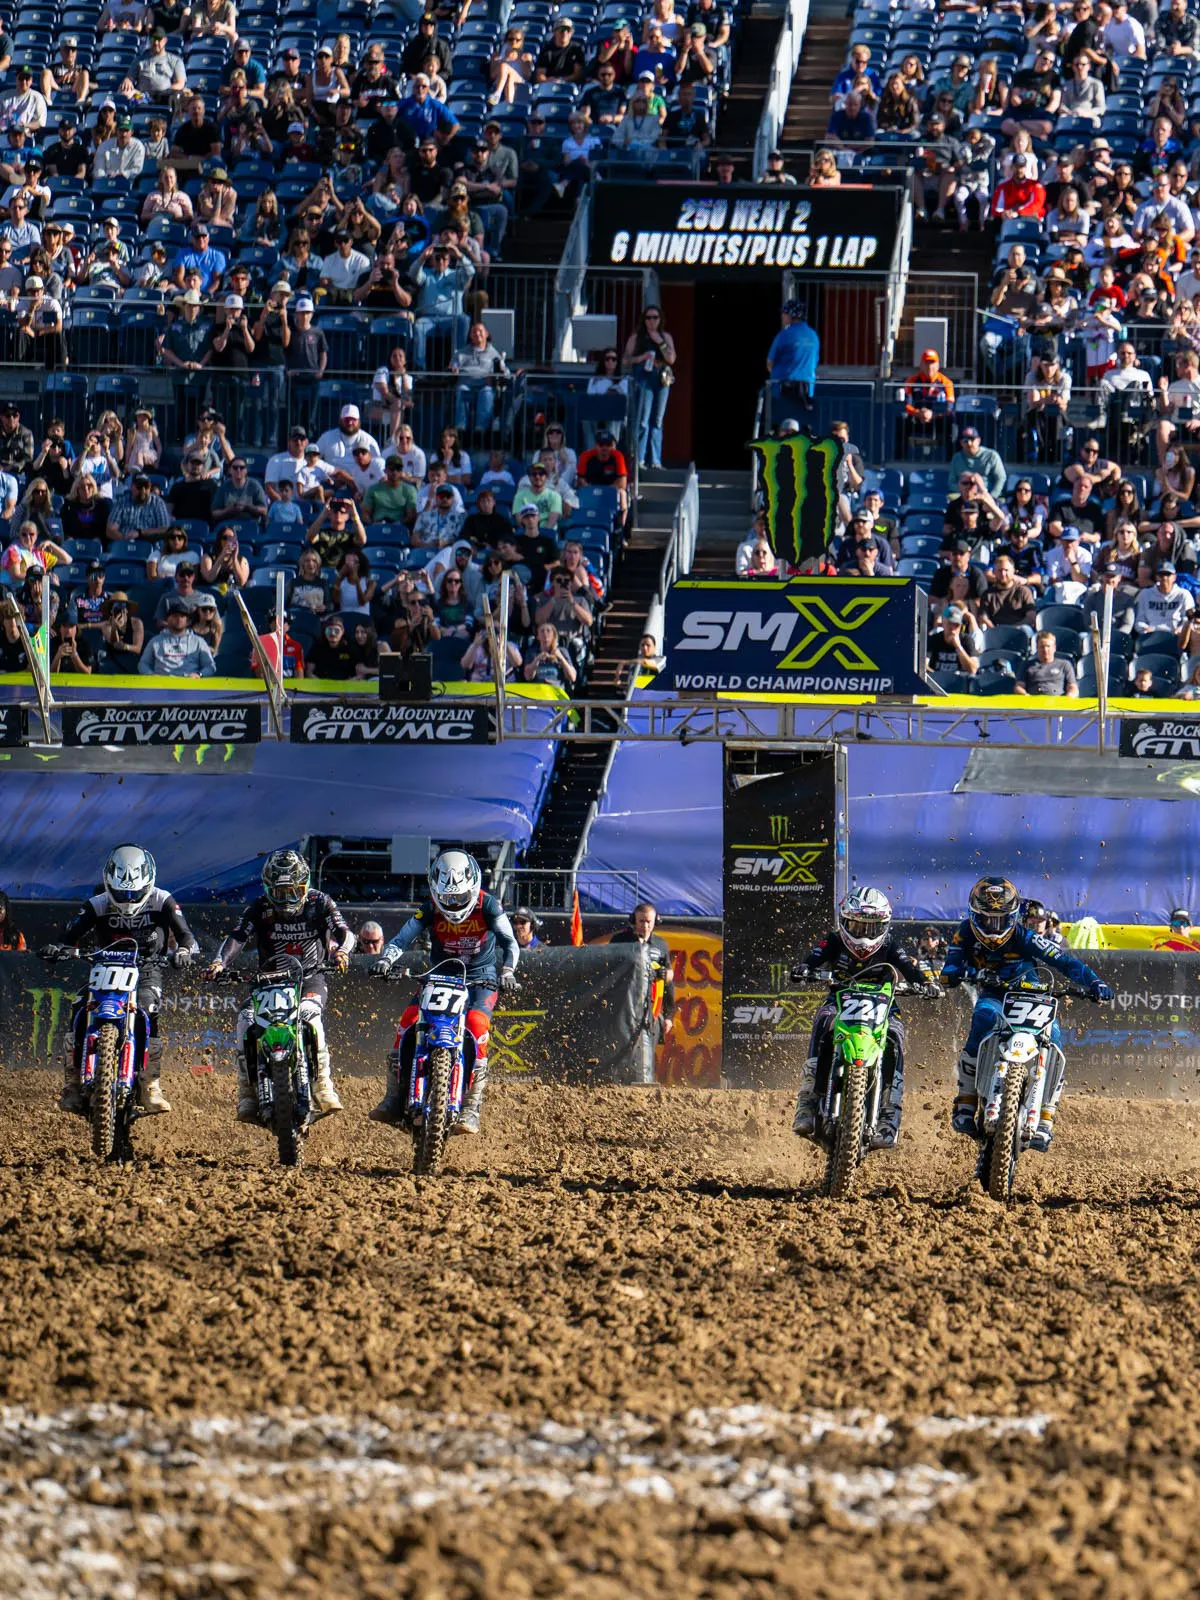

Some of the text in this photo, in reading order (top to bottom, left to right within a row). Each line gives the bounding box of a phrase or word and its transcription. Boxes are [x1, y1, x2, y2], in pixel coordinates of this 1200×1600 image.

[791, 201, 811, 232] 2
[611, 231, 877, 268] 6 MINUTES/PLUS 1 LAP
[673, 595, 890, 671] SMX
[674, 674, 892, 692] WORLD CHAMPIONSHIP
[102, 707, 248, 722] ROCKY MOUNTAIN
[329, 706, 475, 721] ROCKY MOUNTAIN
[731, 851, 823, 884] SMX
[732, 884, 823, 892] WORLD CHAMPIONSHIP
[89, 966, 138, 992] 900
[257, 987, 296, 1013] 203
[421, 986, 467, 1013] 137
[731, 1000, 824, 1032] SMX
[1007, 1001, 1053, 1028] 34
